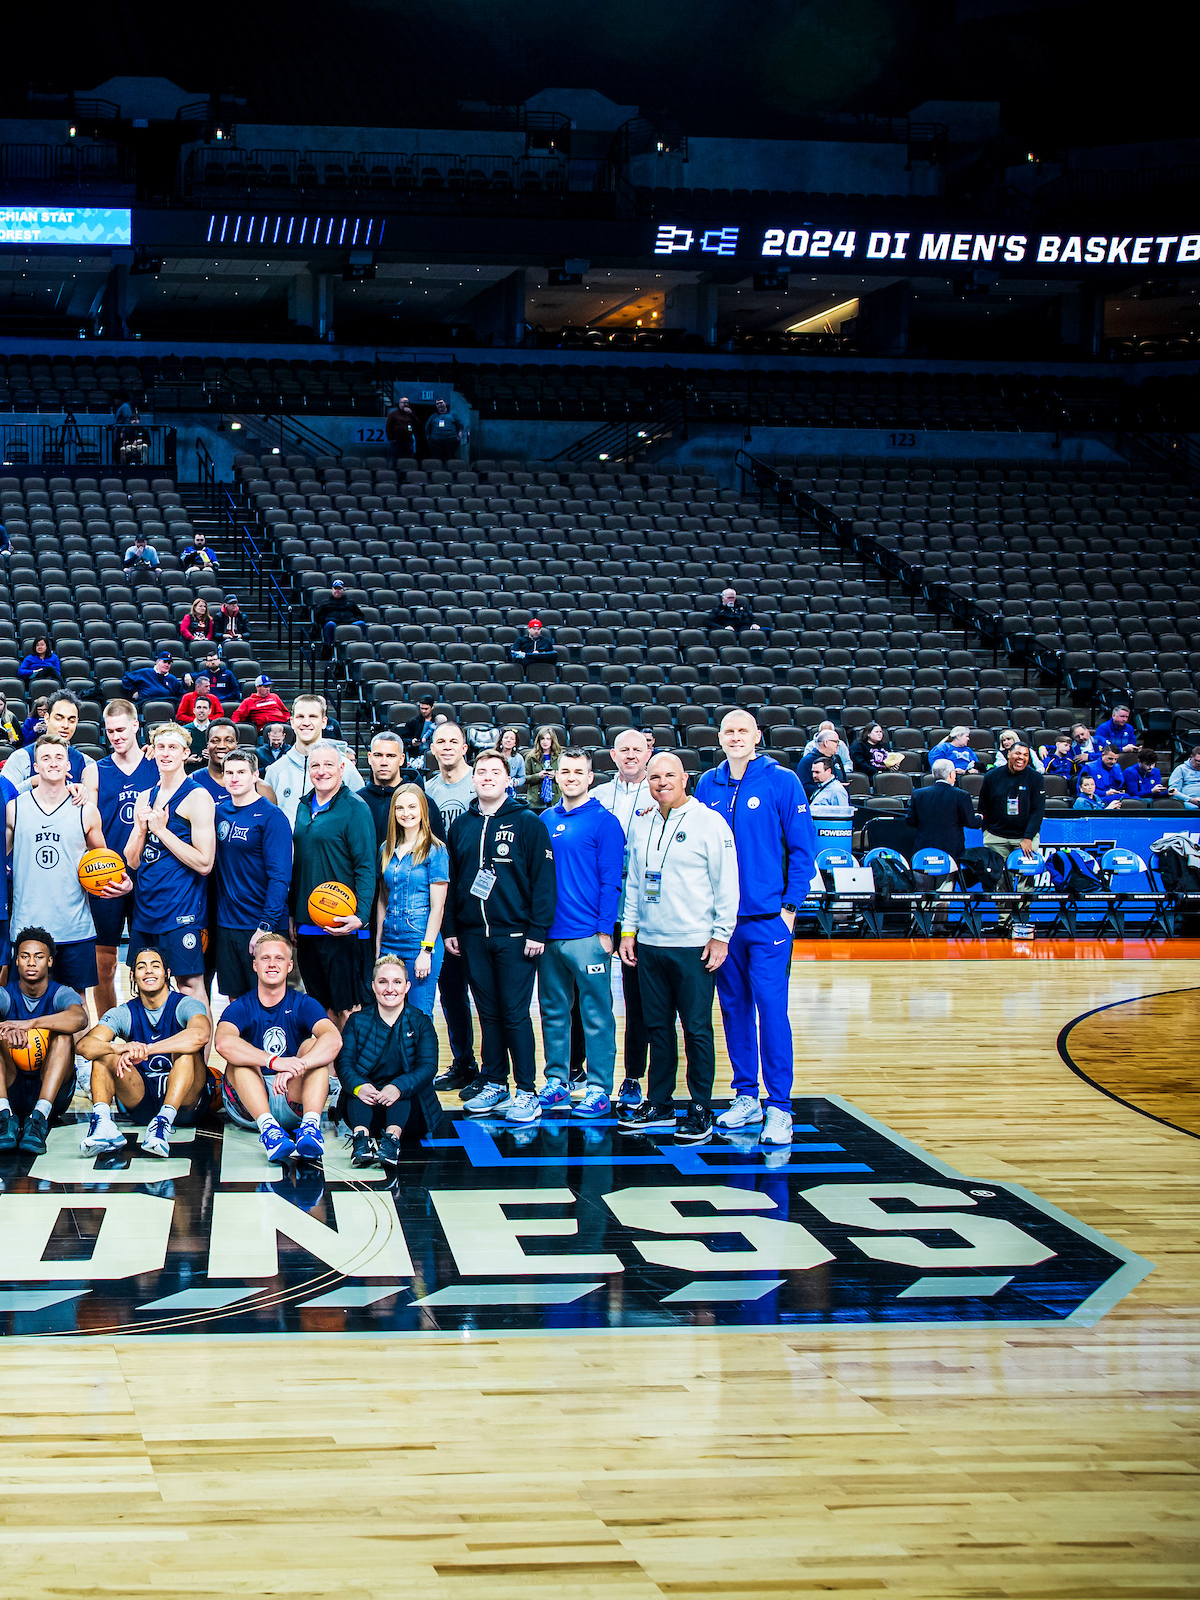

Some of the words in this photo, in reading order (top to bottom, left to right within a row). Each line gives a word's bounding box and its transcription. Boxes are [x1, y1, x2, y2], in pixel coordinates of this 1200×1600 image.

[41, 211, 75, 223] STAT
[761, 228, 856, 258] 2024
[866, 231, 909, 259] DI
[919, 232, 1026, 262] MEN'S
[1036, 233, 1200, 264] BASKETB
[357, 429, 385, 443] 122
[889, 433, 916, 447] 123
[118, 790, 140, 802] BYU
[35, 832, 61, 843] BYU
[494, 830, 515, 843] BYU
[42, 850, 53, 864] 51
[84, 861, 117, 874] Wilson
[320, 883, 350, 901] Wilson
